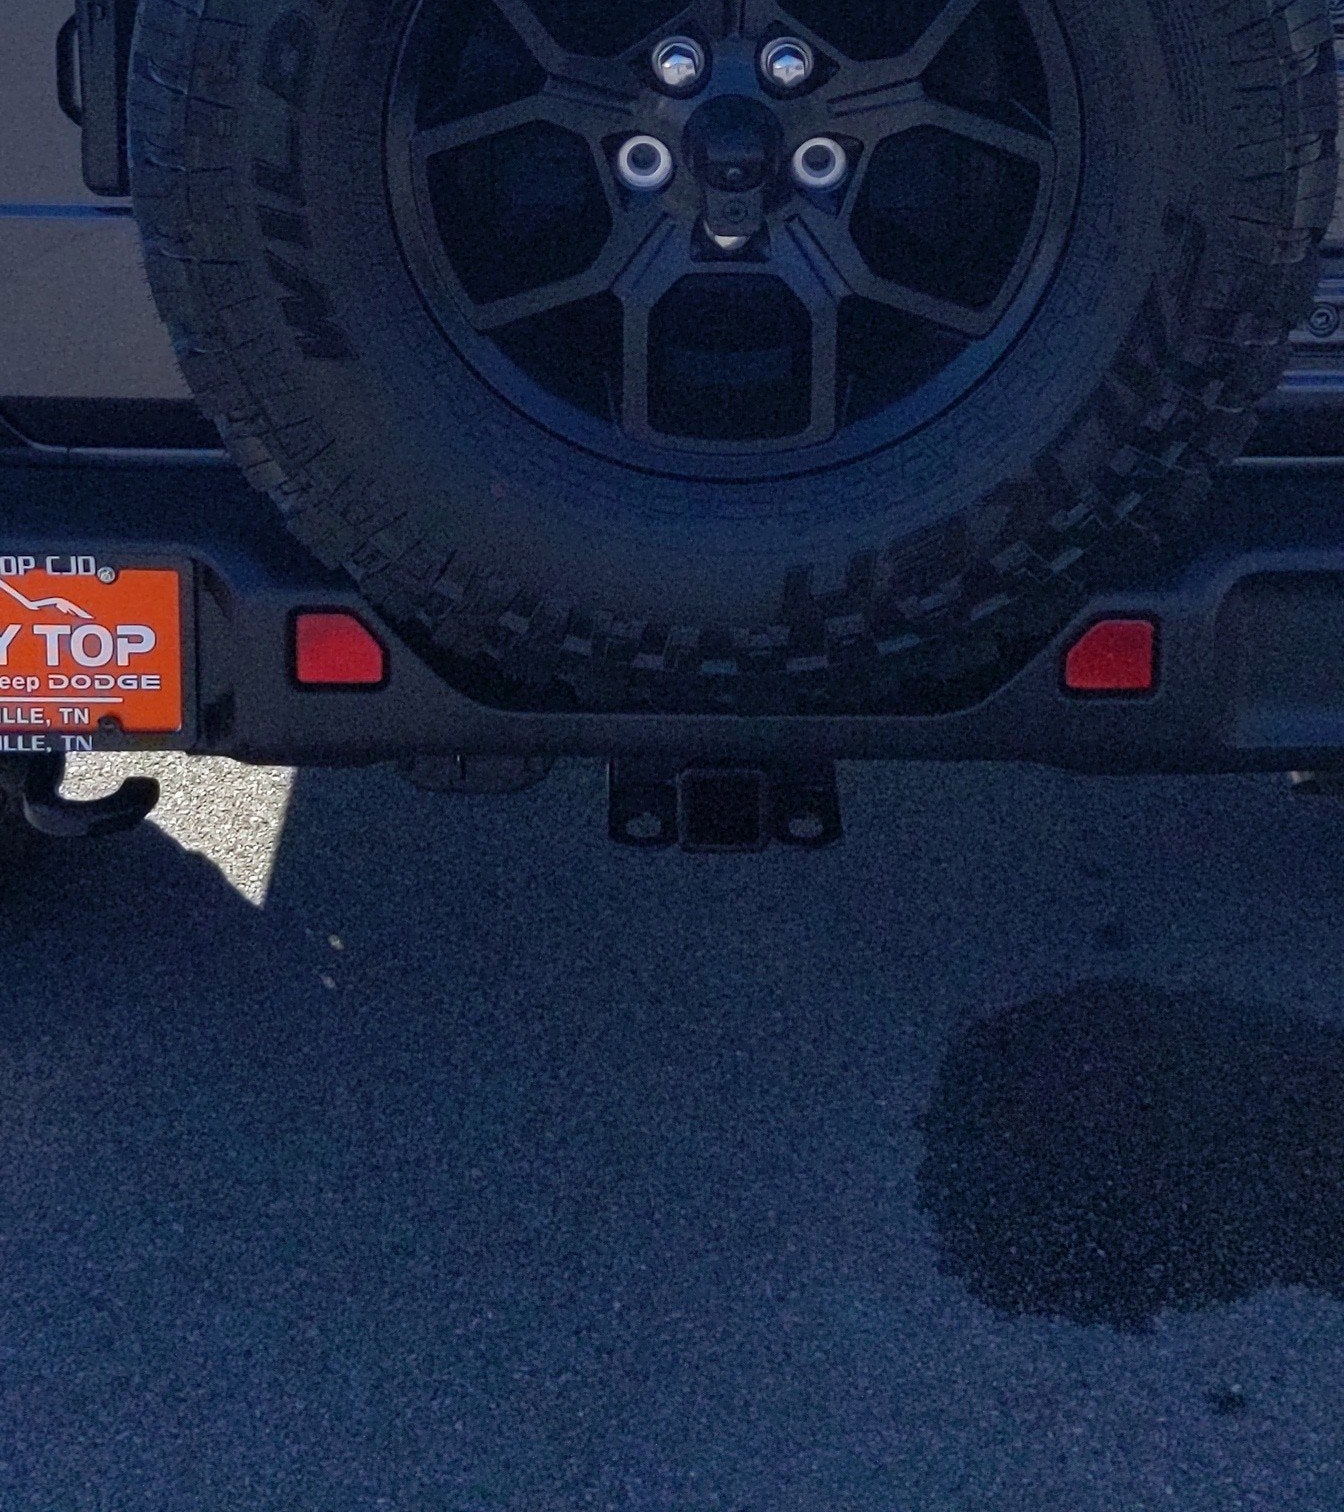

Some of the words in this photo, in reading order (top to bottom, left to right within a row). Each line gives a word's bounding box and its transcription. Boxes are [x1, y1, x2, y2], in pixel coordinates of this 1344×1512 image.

[45, 555, 96, 576] CJD
[33, 624, 156, 667] TOP
[48, 675, 162, 690] DODGE
[59, 708, 90, 725] TN
[64, 734, 93, 751] TN
